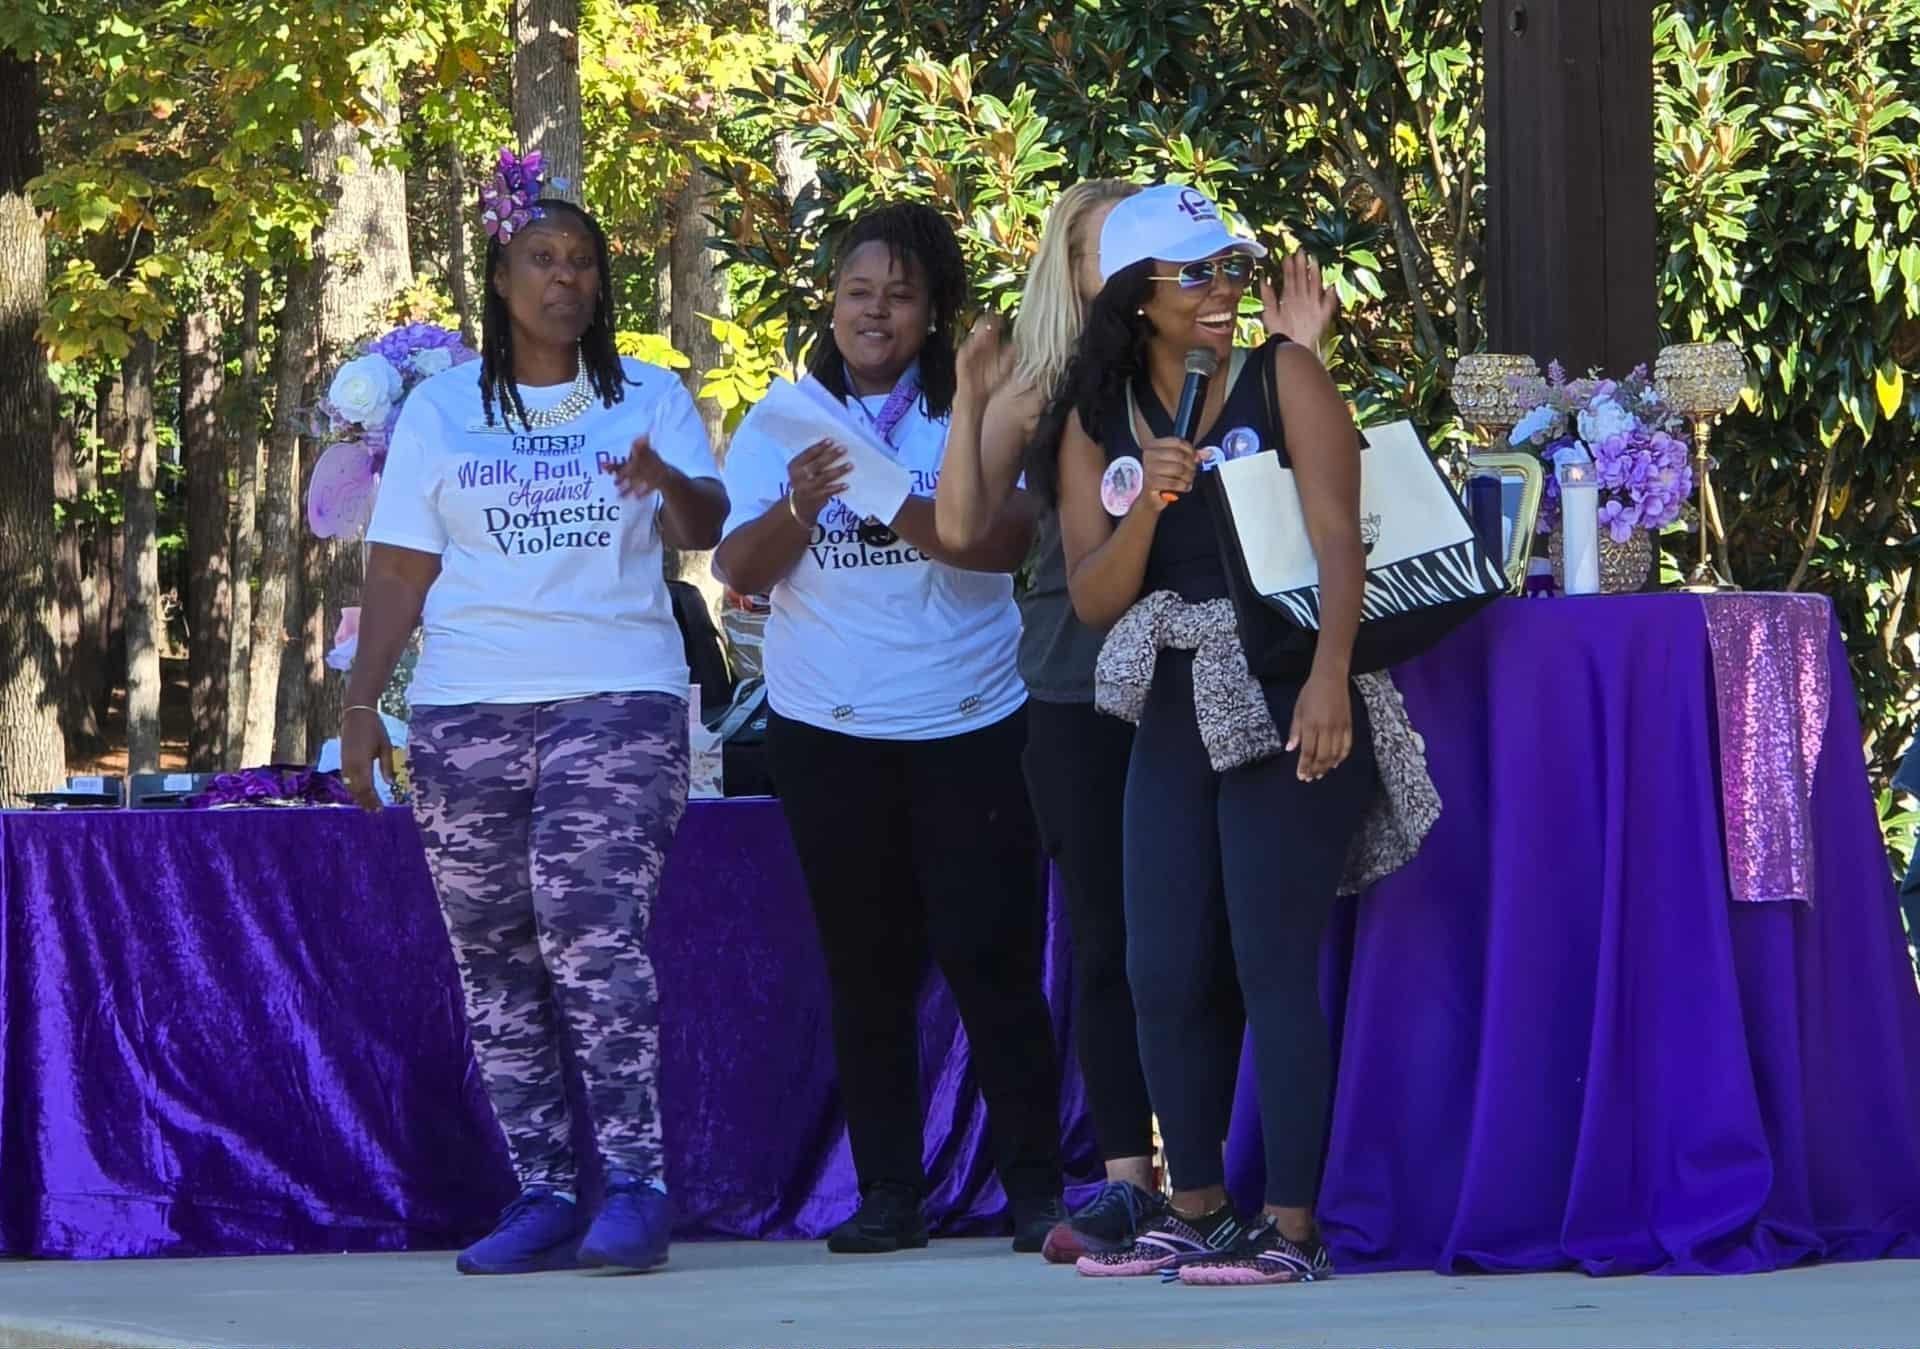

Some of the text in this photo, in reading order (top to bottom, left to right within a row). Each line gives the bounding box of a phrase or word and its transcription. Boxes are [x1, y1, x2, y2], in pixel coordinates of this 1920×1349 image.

[512, 434, 586, 452] HUSH
[457, 450, 632, 490] Walk, Roll, Ru
[483, 497, 620, 533] Domestic
[508, 478, 594, 521] Against
[491, 525, 611, 556] Violence
